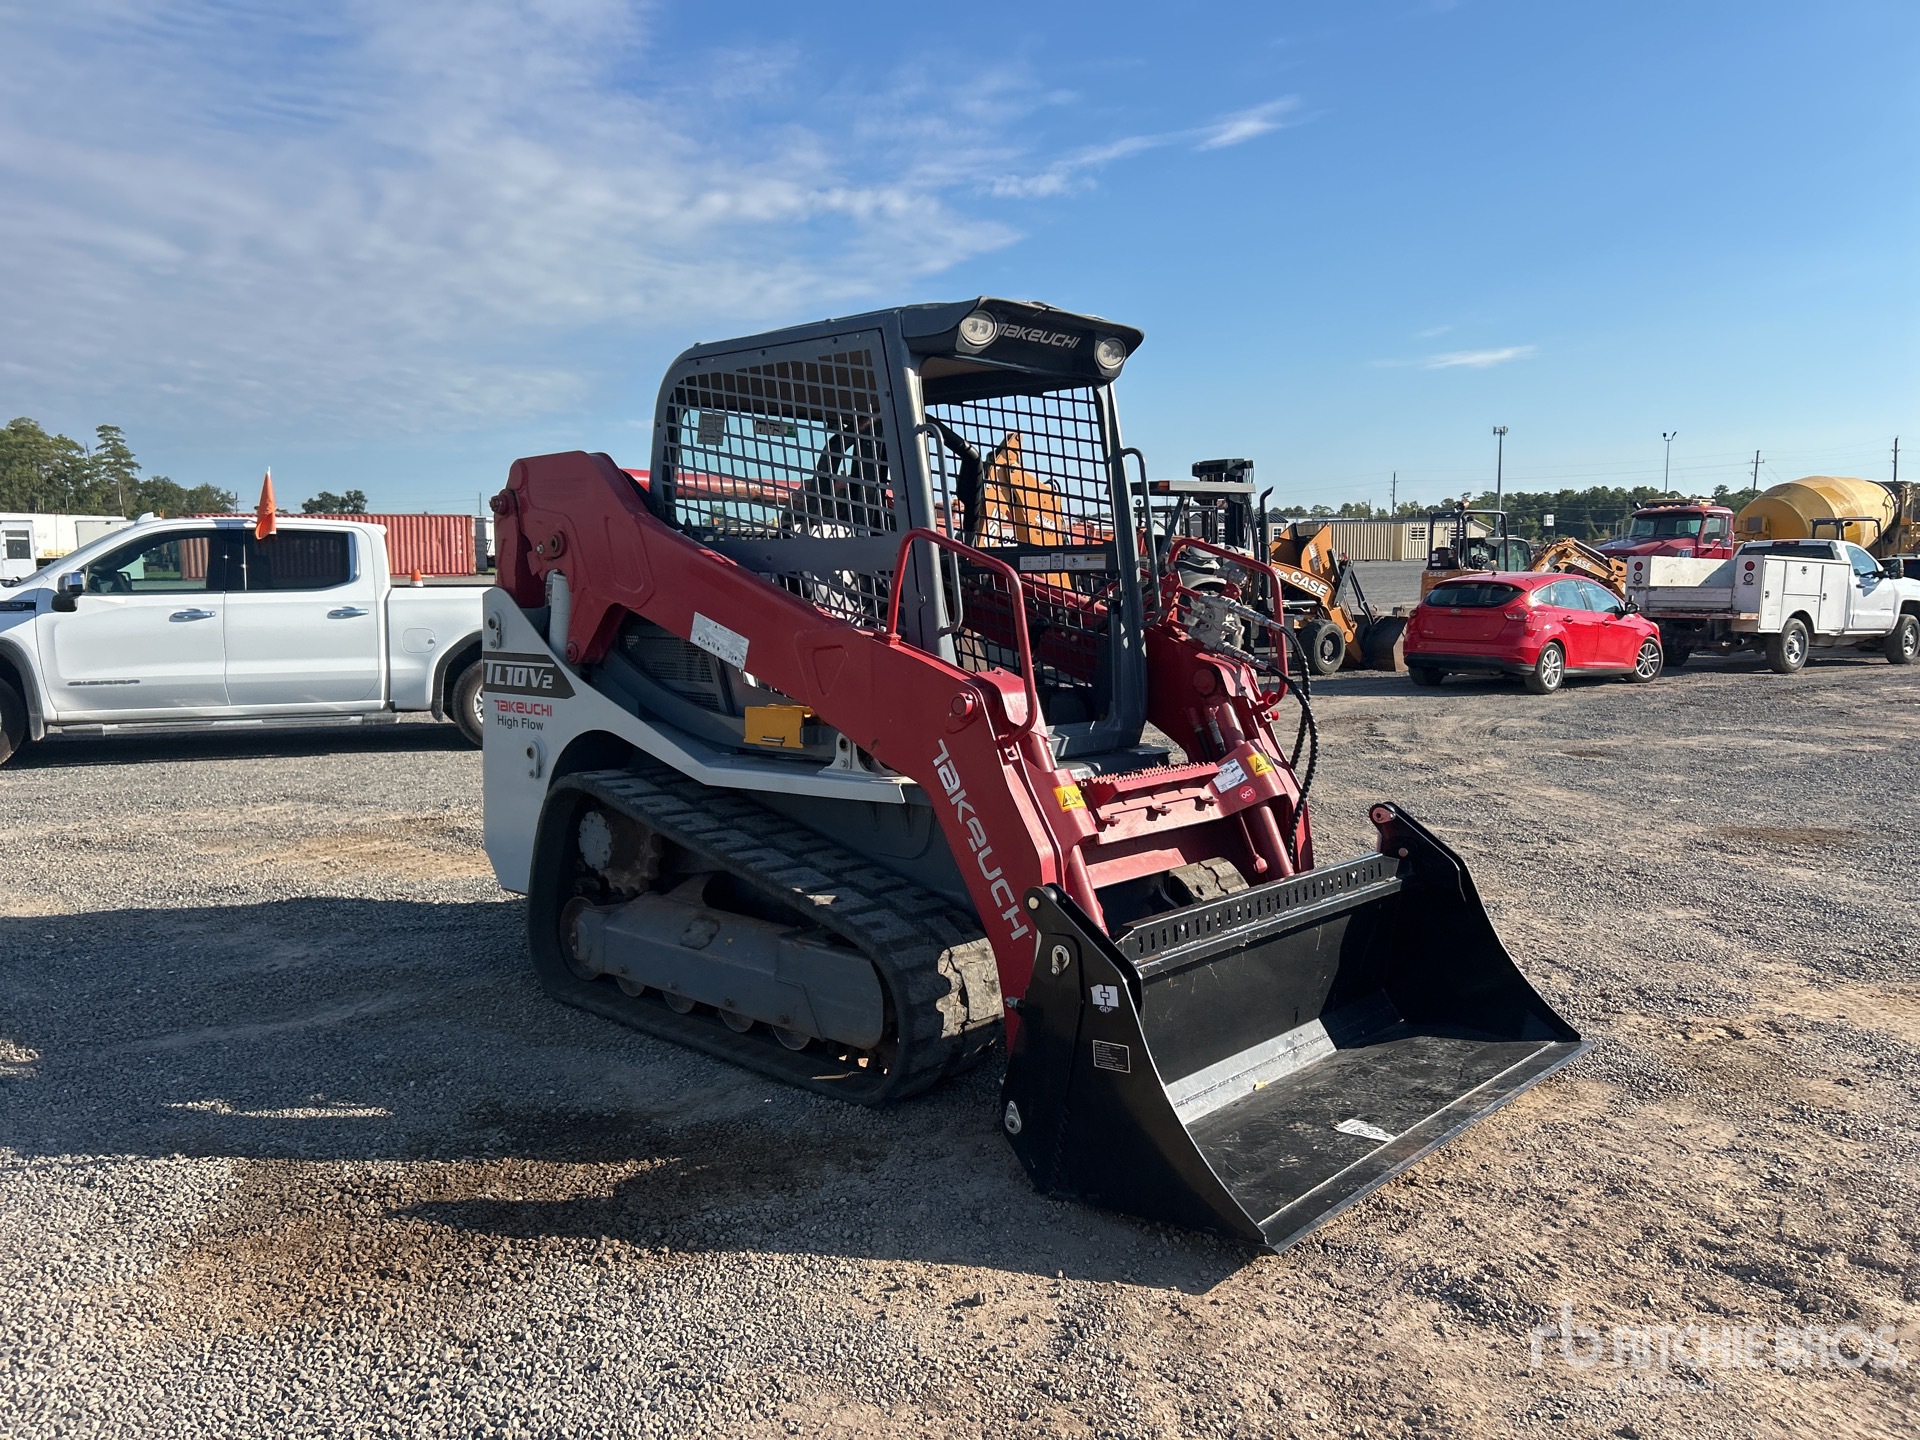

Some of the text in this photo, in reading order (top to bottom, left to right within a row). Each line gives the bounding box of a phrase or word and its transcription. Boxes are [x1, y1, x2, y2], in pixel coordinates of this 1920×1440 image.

[1571, 556, 1592, 570] CASE
[1290, 571, 1328, 597] CASE
[497, 715, 544, 730] High Flow
[1241, 787, 1254, 799] OCT
[932, 738, 1031, 941] TAKEUCH
